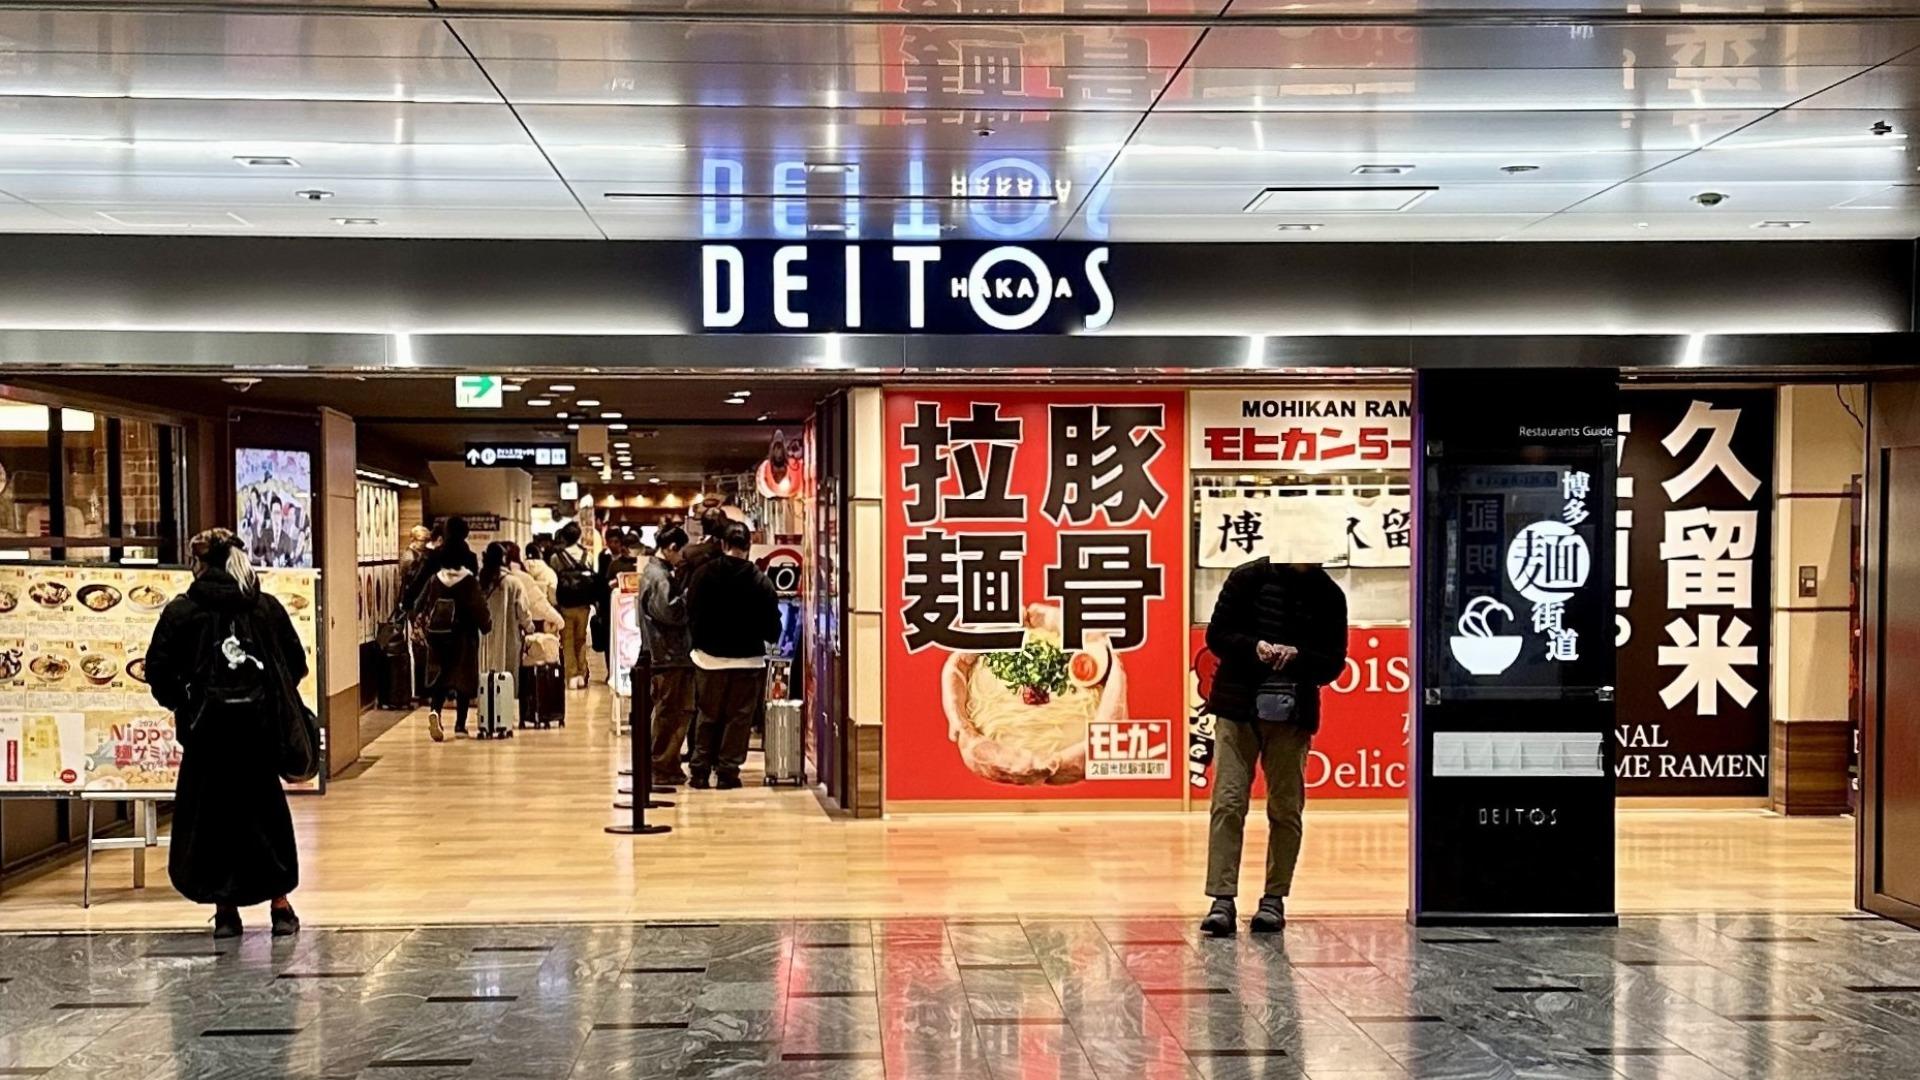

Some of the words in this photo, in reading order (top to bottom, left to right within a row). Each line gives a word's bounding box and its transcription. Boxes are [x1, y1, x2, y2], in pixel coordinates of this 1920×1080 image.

[701, 244, 1116, 331] DEITOS
[950, 276, 1074, 299] HAKAA
[1242, 400, 1356, 418] MOHIKAN
[1519, 425, 1580, 437] Restaurants
[1582, 425, 1614, 437] Guide
[900, 401, 1028, 655] 拉麺
[1041, 402, 1168, 654] 豚骨
[1217, 510, 1264, 554] 博
[1658, 399, 1762, 715] 久留米
[110, 723, 174, 745] Nippo
[1089, 723, 1167, 760] モヒカン
[1659, 754, 1767, 778] RAMEN
[1478, 807, 1557, 826] DEITOS
